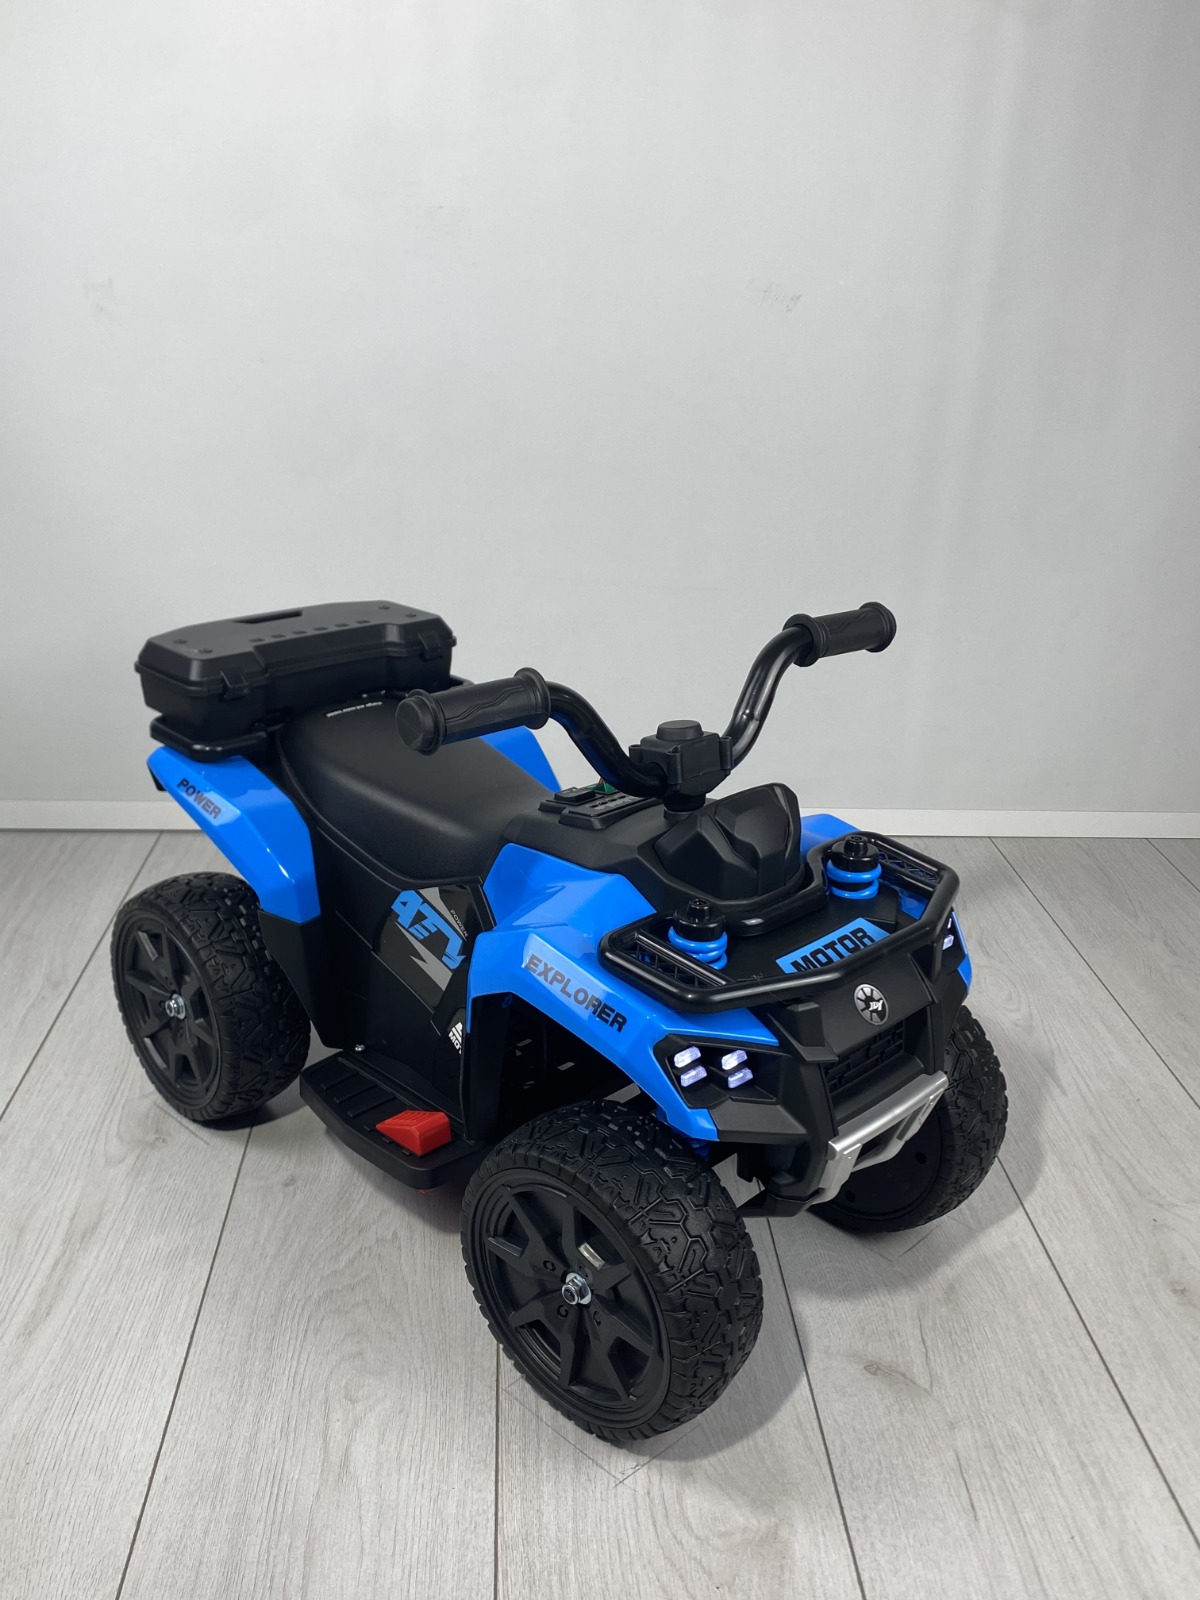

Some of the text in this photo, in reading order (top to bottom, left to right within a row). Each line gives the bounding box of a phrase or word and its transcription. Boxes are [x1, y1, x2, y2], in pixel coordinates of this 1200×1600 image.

[177, 777, 222, 819] POWER
[450, 909, 469, 937] POWER
[790, 927, 876, 972] MOTOR
[525, 954, 628, 1033] EXPLORER
